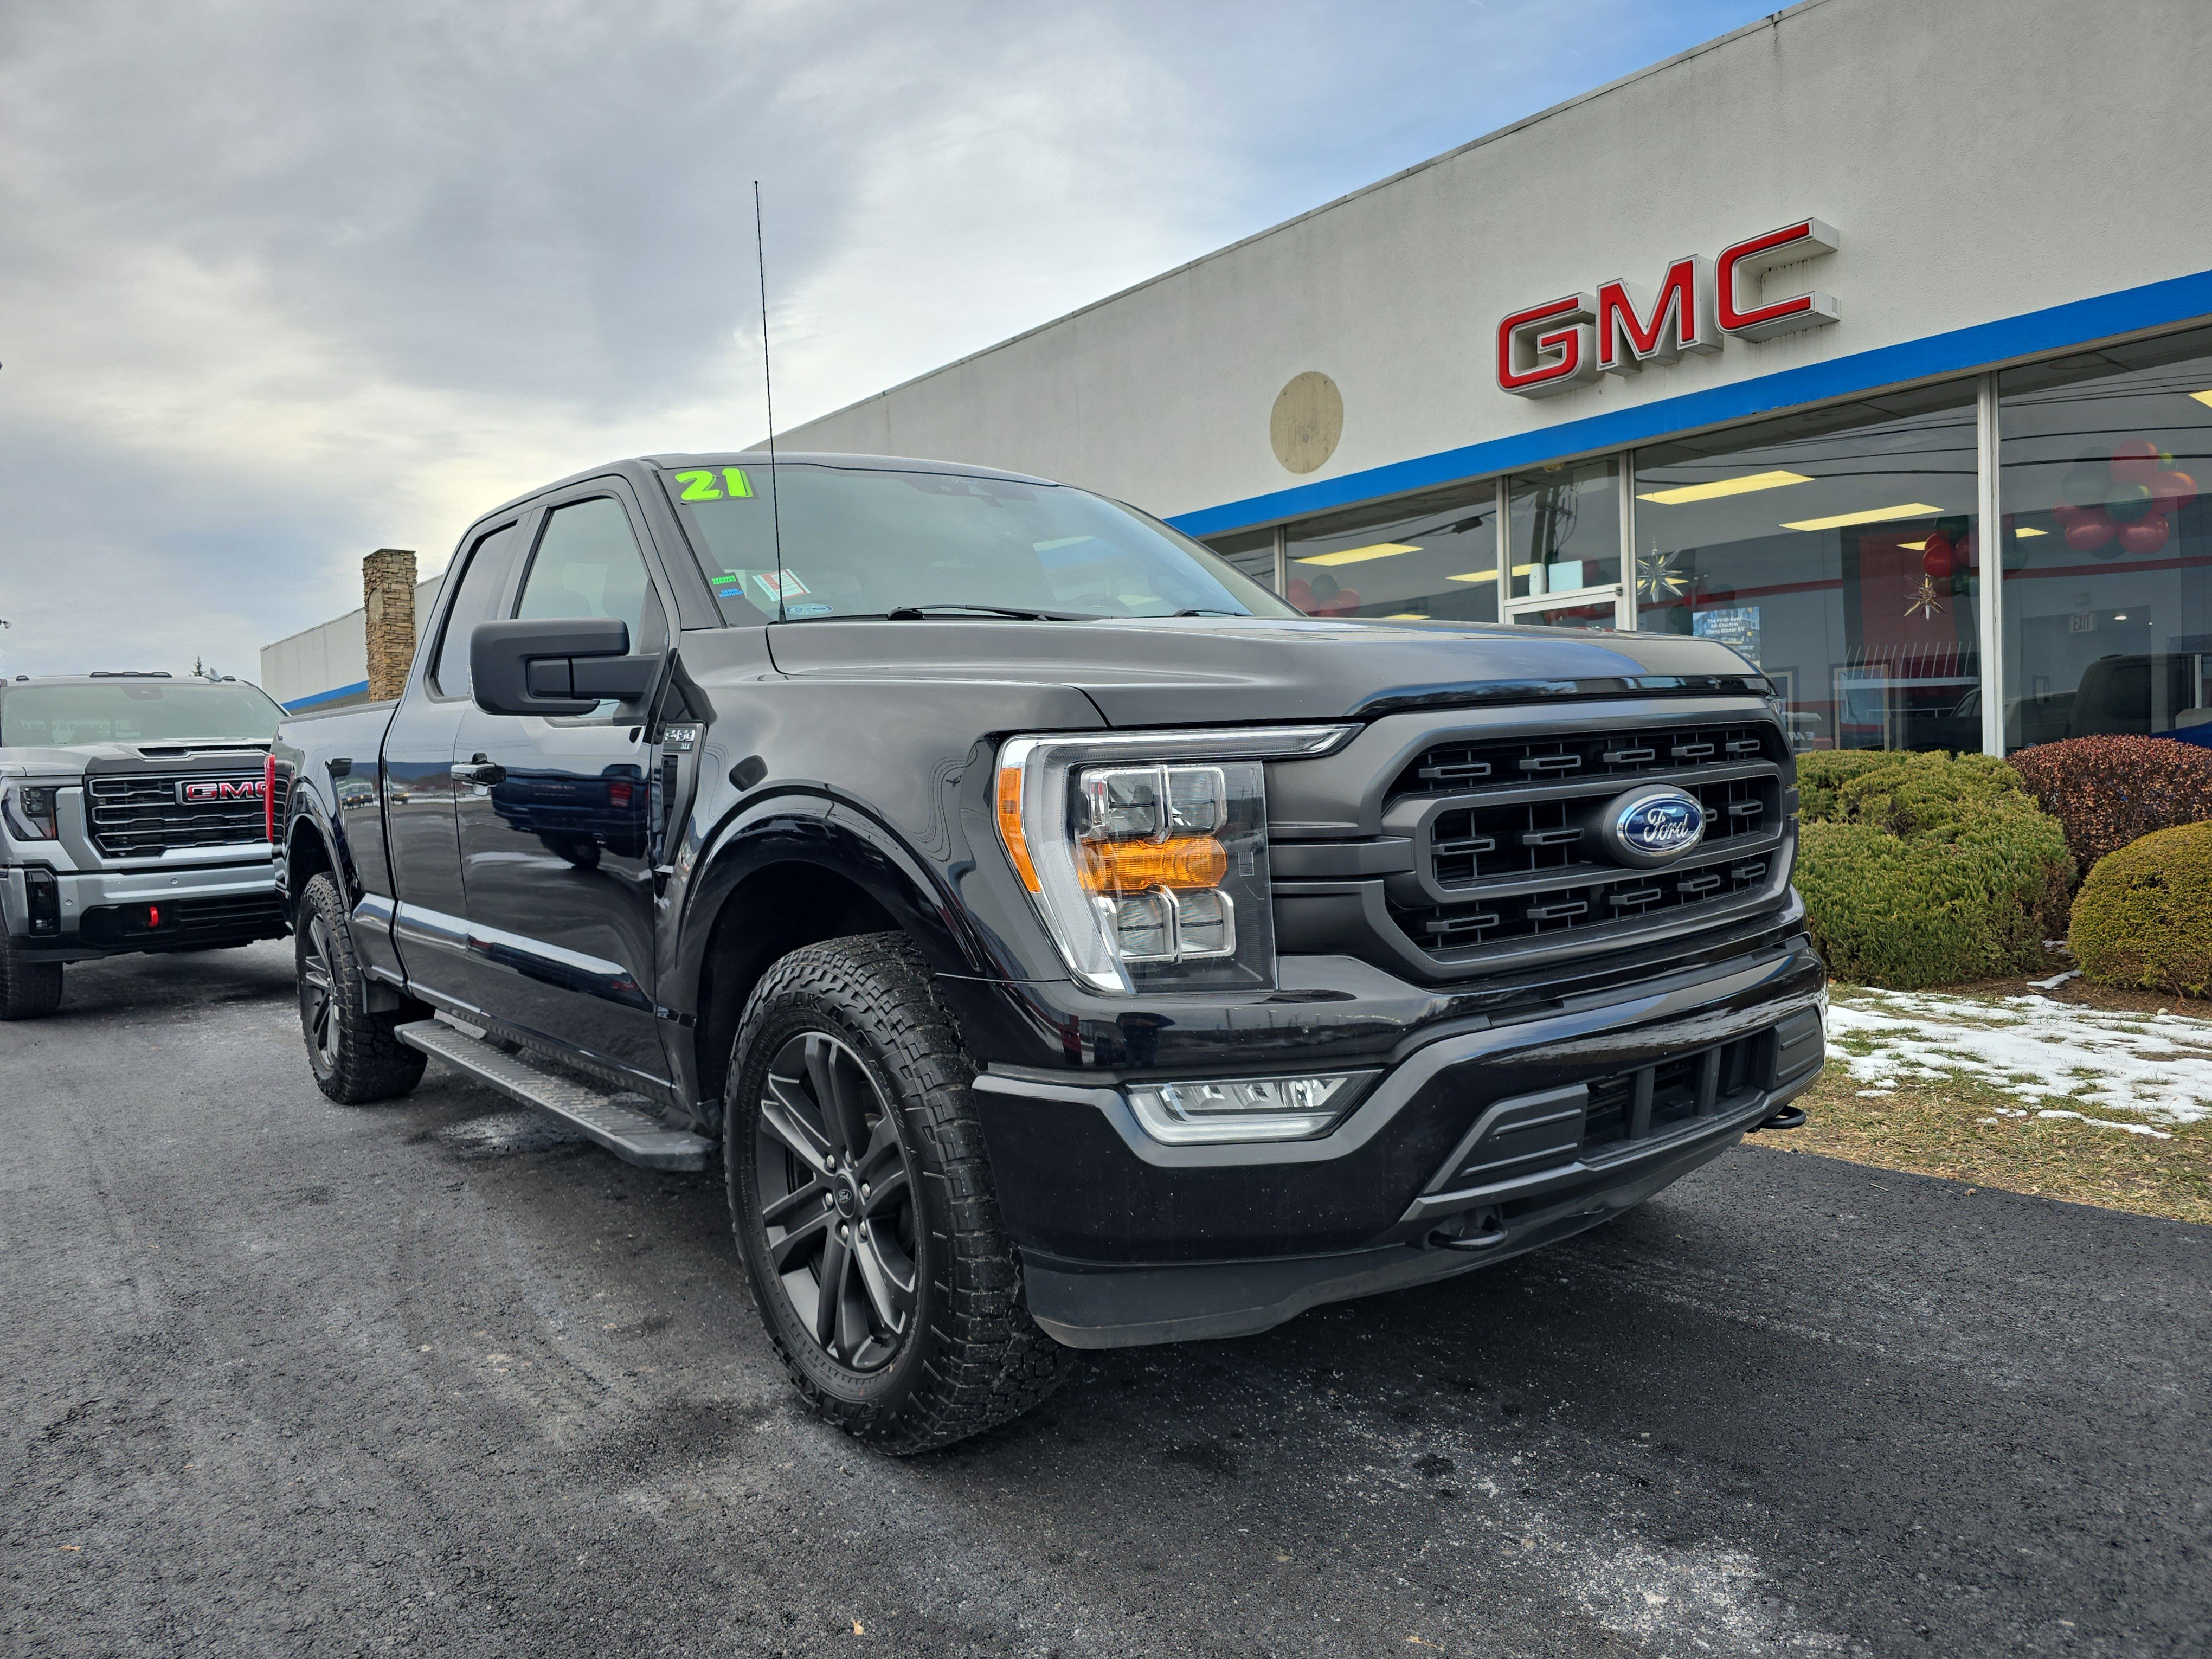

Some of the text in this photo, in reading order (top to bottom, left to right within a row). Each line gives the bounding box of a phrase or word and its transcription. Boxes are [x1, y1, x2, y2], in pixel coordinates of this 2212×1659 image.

[1496, 217, 1821, 395] GMC
[675, 467, 753, 501] 21
[2073, 614, 2091, 631] EXIT
[1643, 807, 1689, 843] Ford
